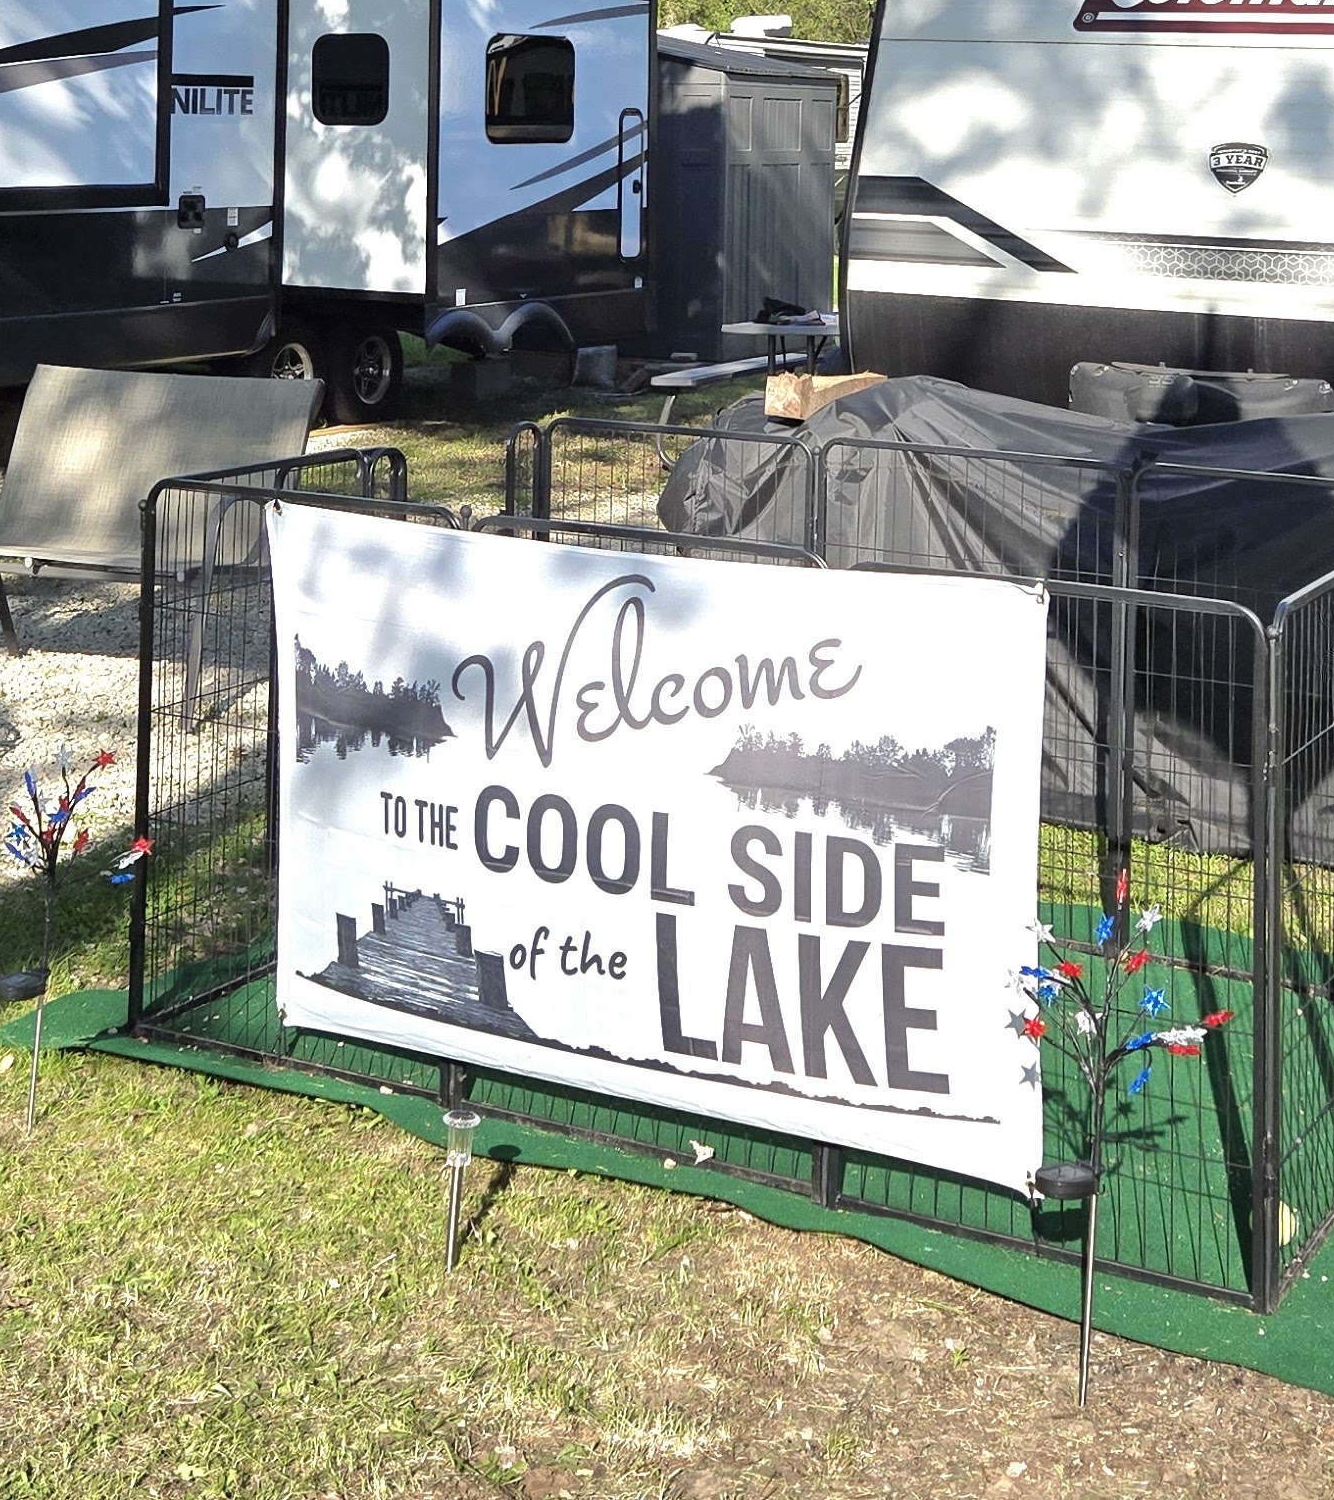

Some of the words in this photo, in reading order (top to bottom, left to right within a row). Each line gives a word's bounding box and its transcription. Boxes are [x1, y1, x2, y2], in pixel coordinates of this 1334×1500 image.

[1213, 156, 1221, 167] 3
[1225, 154, 1264, 167] YEAR
[452, 574, 862, 768] Welcome
[380, 791, 406, 839] TO
[414, 799, 459, 850] THE
[474, 785, 695, 906] COOL
[728, 825, 945, 936] SIDE
[509, 926, 550, 980] of
[559, 931, 628, 980] the
[656, 912, 950, 1094] LAKE
